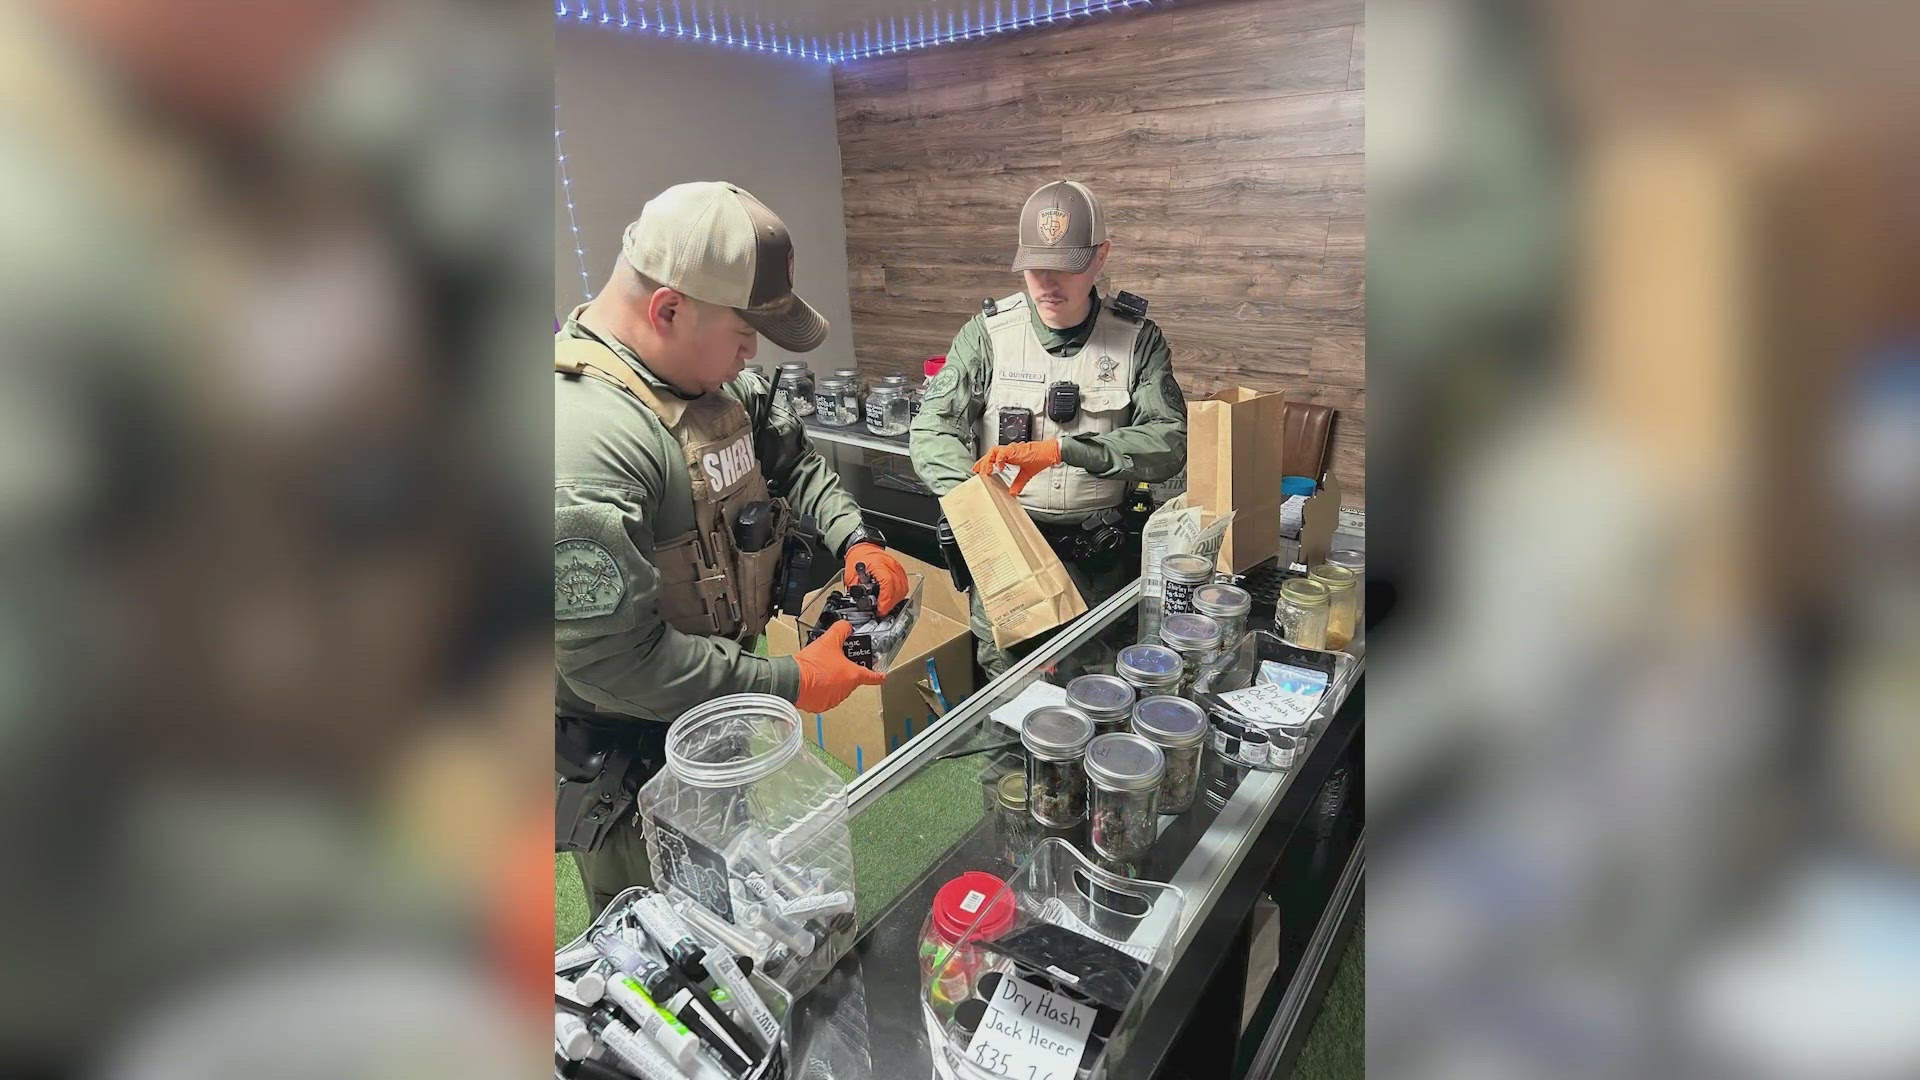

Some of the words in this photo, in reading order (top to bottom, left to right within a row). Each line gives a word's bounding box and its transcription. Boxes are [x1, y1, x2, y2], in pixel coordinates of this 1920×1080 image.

[843, 640, 860, 648] agic
[847, 648, 871, 658] Exotic
[1231, 694, 1261, 713] $35
[1248, 689, 1265, 700] OG
[1265, 700, 1289, 717] Kush
[1263, 684, 1281, 699] Dry
[1281, 697, 1307, 715] Hash
[1002, 979, 1032, 1016] Dry
[1036, 992, 1081, 1029] Hash
[985, 1006, 1023, 1041] Jack
[1028, 1025, 1075, 1057] Herer
[976, 1040, 1012, 1076] $35
